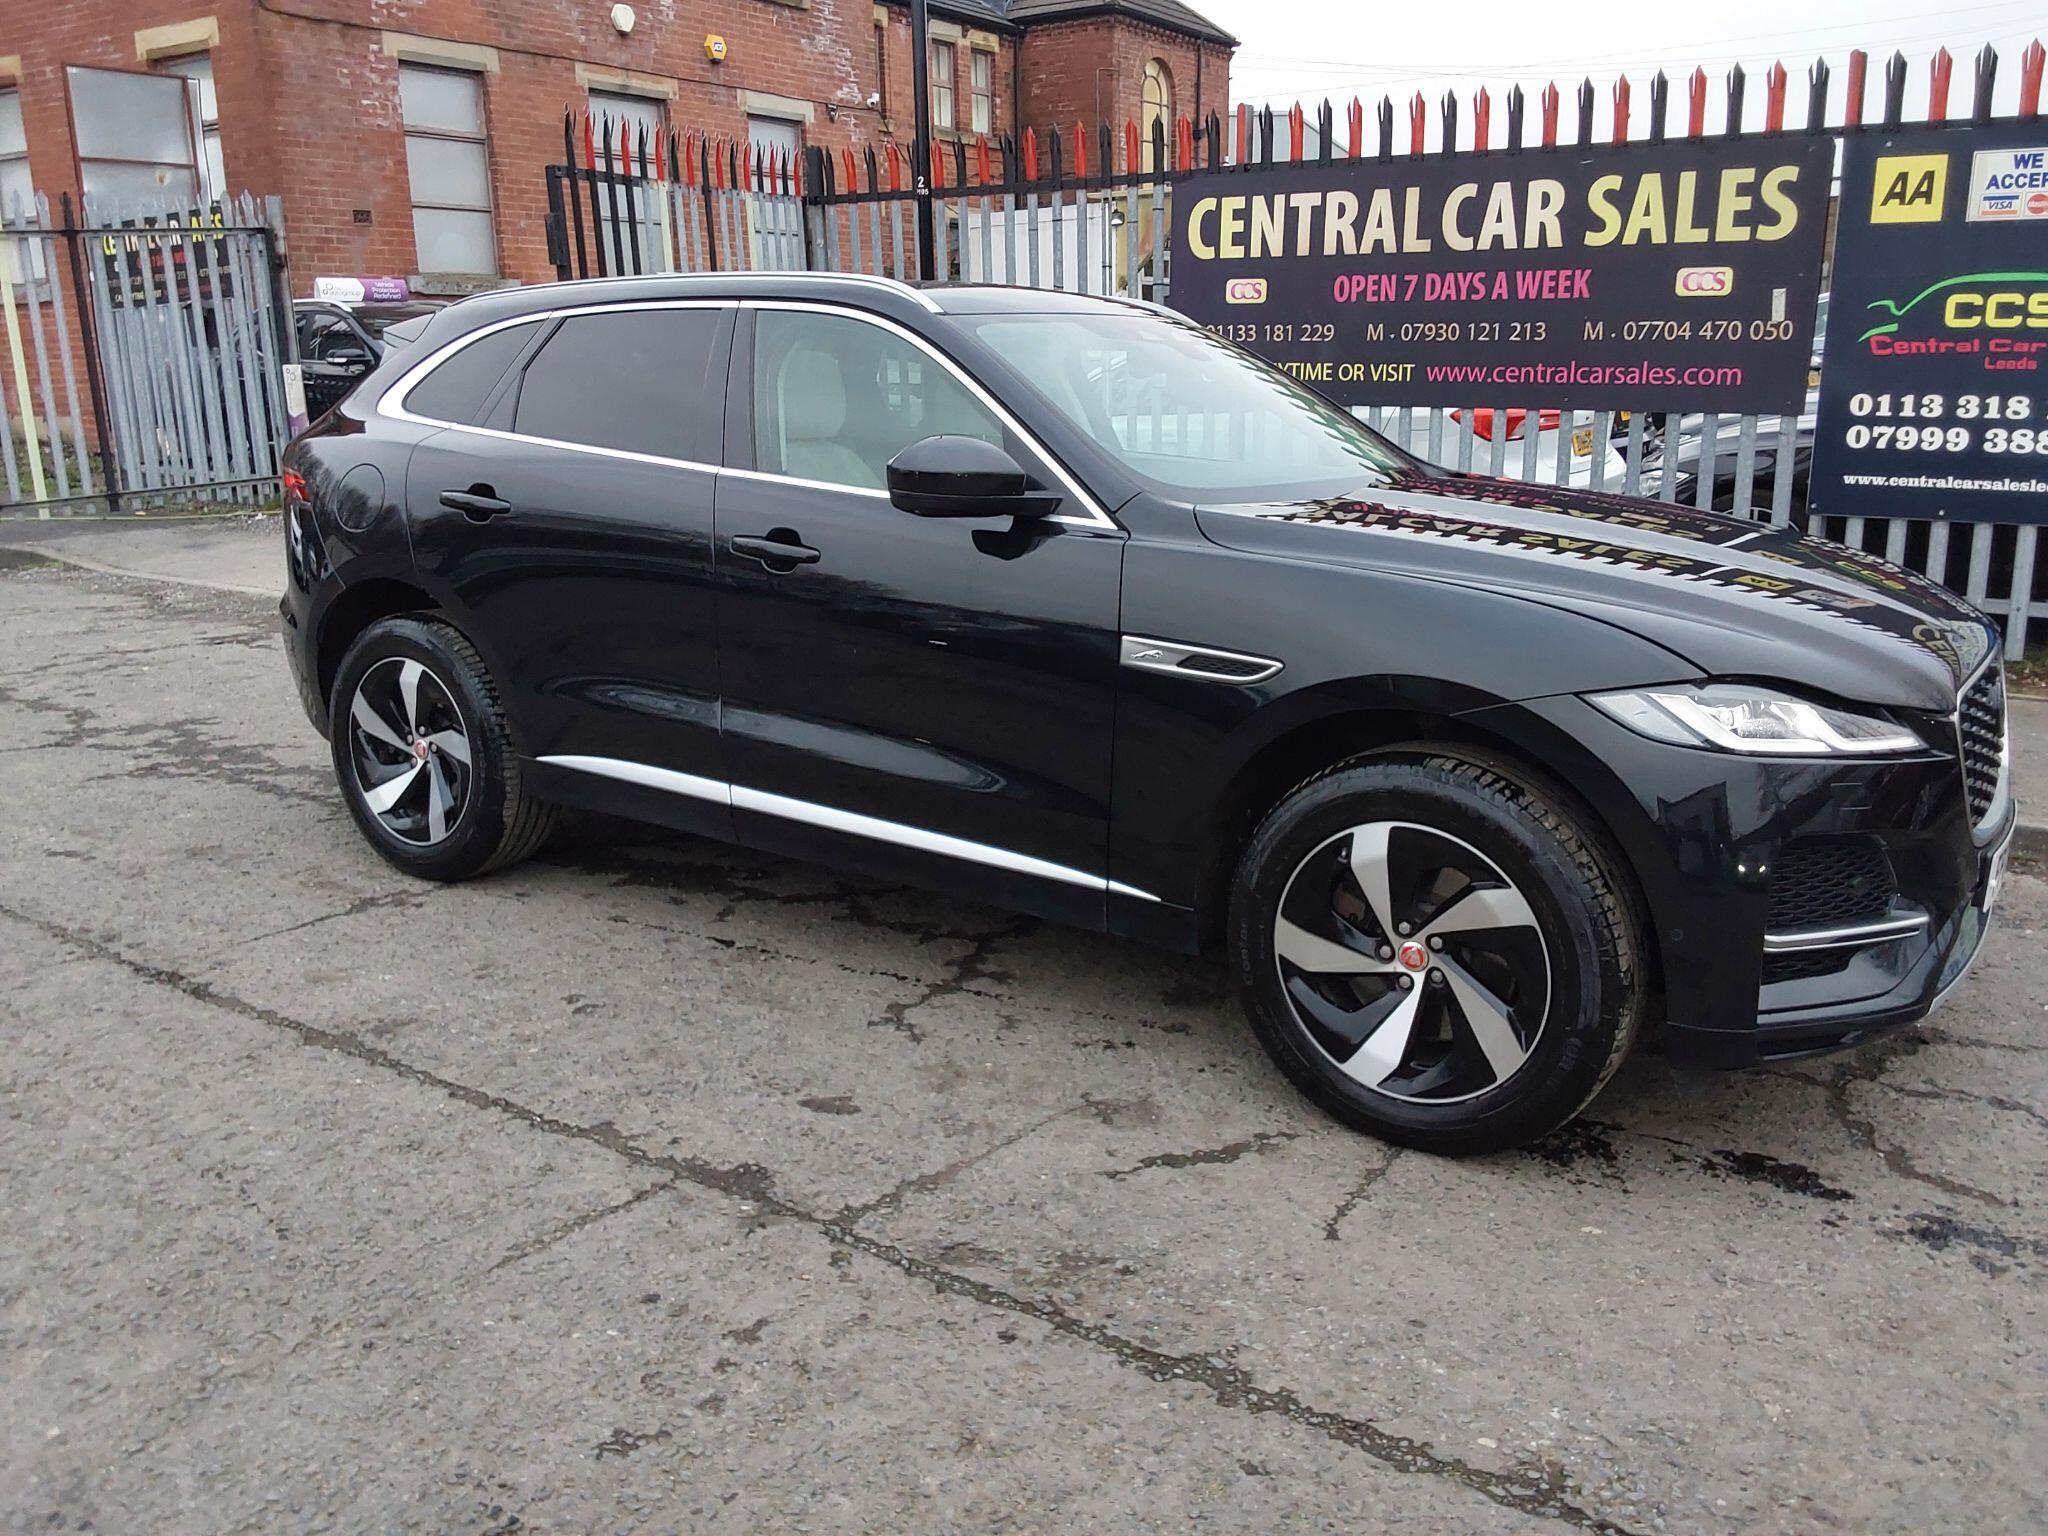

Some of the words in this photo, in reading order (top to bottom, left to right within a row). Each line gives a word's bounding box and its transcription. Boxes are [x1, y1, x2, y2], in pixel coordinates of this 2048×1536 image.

[2014, 153, 2044, 169] WE
[917, 176, 925, 188] 2
[1880, 170, 1936, 207] AA
[1188, 187, 1432, 259] CENTRAL
[1442, 179, 1565, 251] CAR
[1584, 165, 1800, 247] SALES
[1989, 200, 2013, 209] VISA
[1333, 274, 1397, 303] OPEN
[1404, 275, 1419, 301] 7
[1424, 271, 1486, 301] DAYS
[1491, 271, 1508, 300] A
[1516, 268, 1592, 299] WEEK
[1264, 324, 1293, 342] 181
[1300, 323, 1335, 342] 229
[1401, 323, 1460, 341] 07930
[1468, 323, 1499, 341] 121
[1509, 322, 1546, 341] 213
[1624, 321, 1691, 341] 07704
[1699, 321, 1742, 340] 470
[1749, 320, 1794, 341] 050
[1869, 335, 1980, 356] Central
[1989, 338, 2047, 353] Car
[1338, 363, 1365, 381] OR
[1370, 364, 1415, 381] VISIT
[1426, 361, 1743, 386] www.centralcarsales.com
[1984, 356, 2037, 370] Leeds
[1850, 393, 1944, 418] 0113
[1956, 395, 2030, 420] 318
[1846, 425, 1970, 452] 07999
[1843, 475, 2048, 493] www.centralcarsalesle
